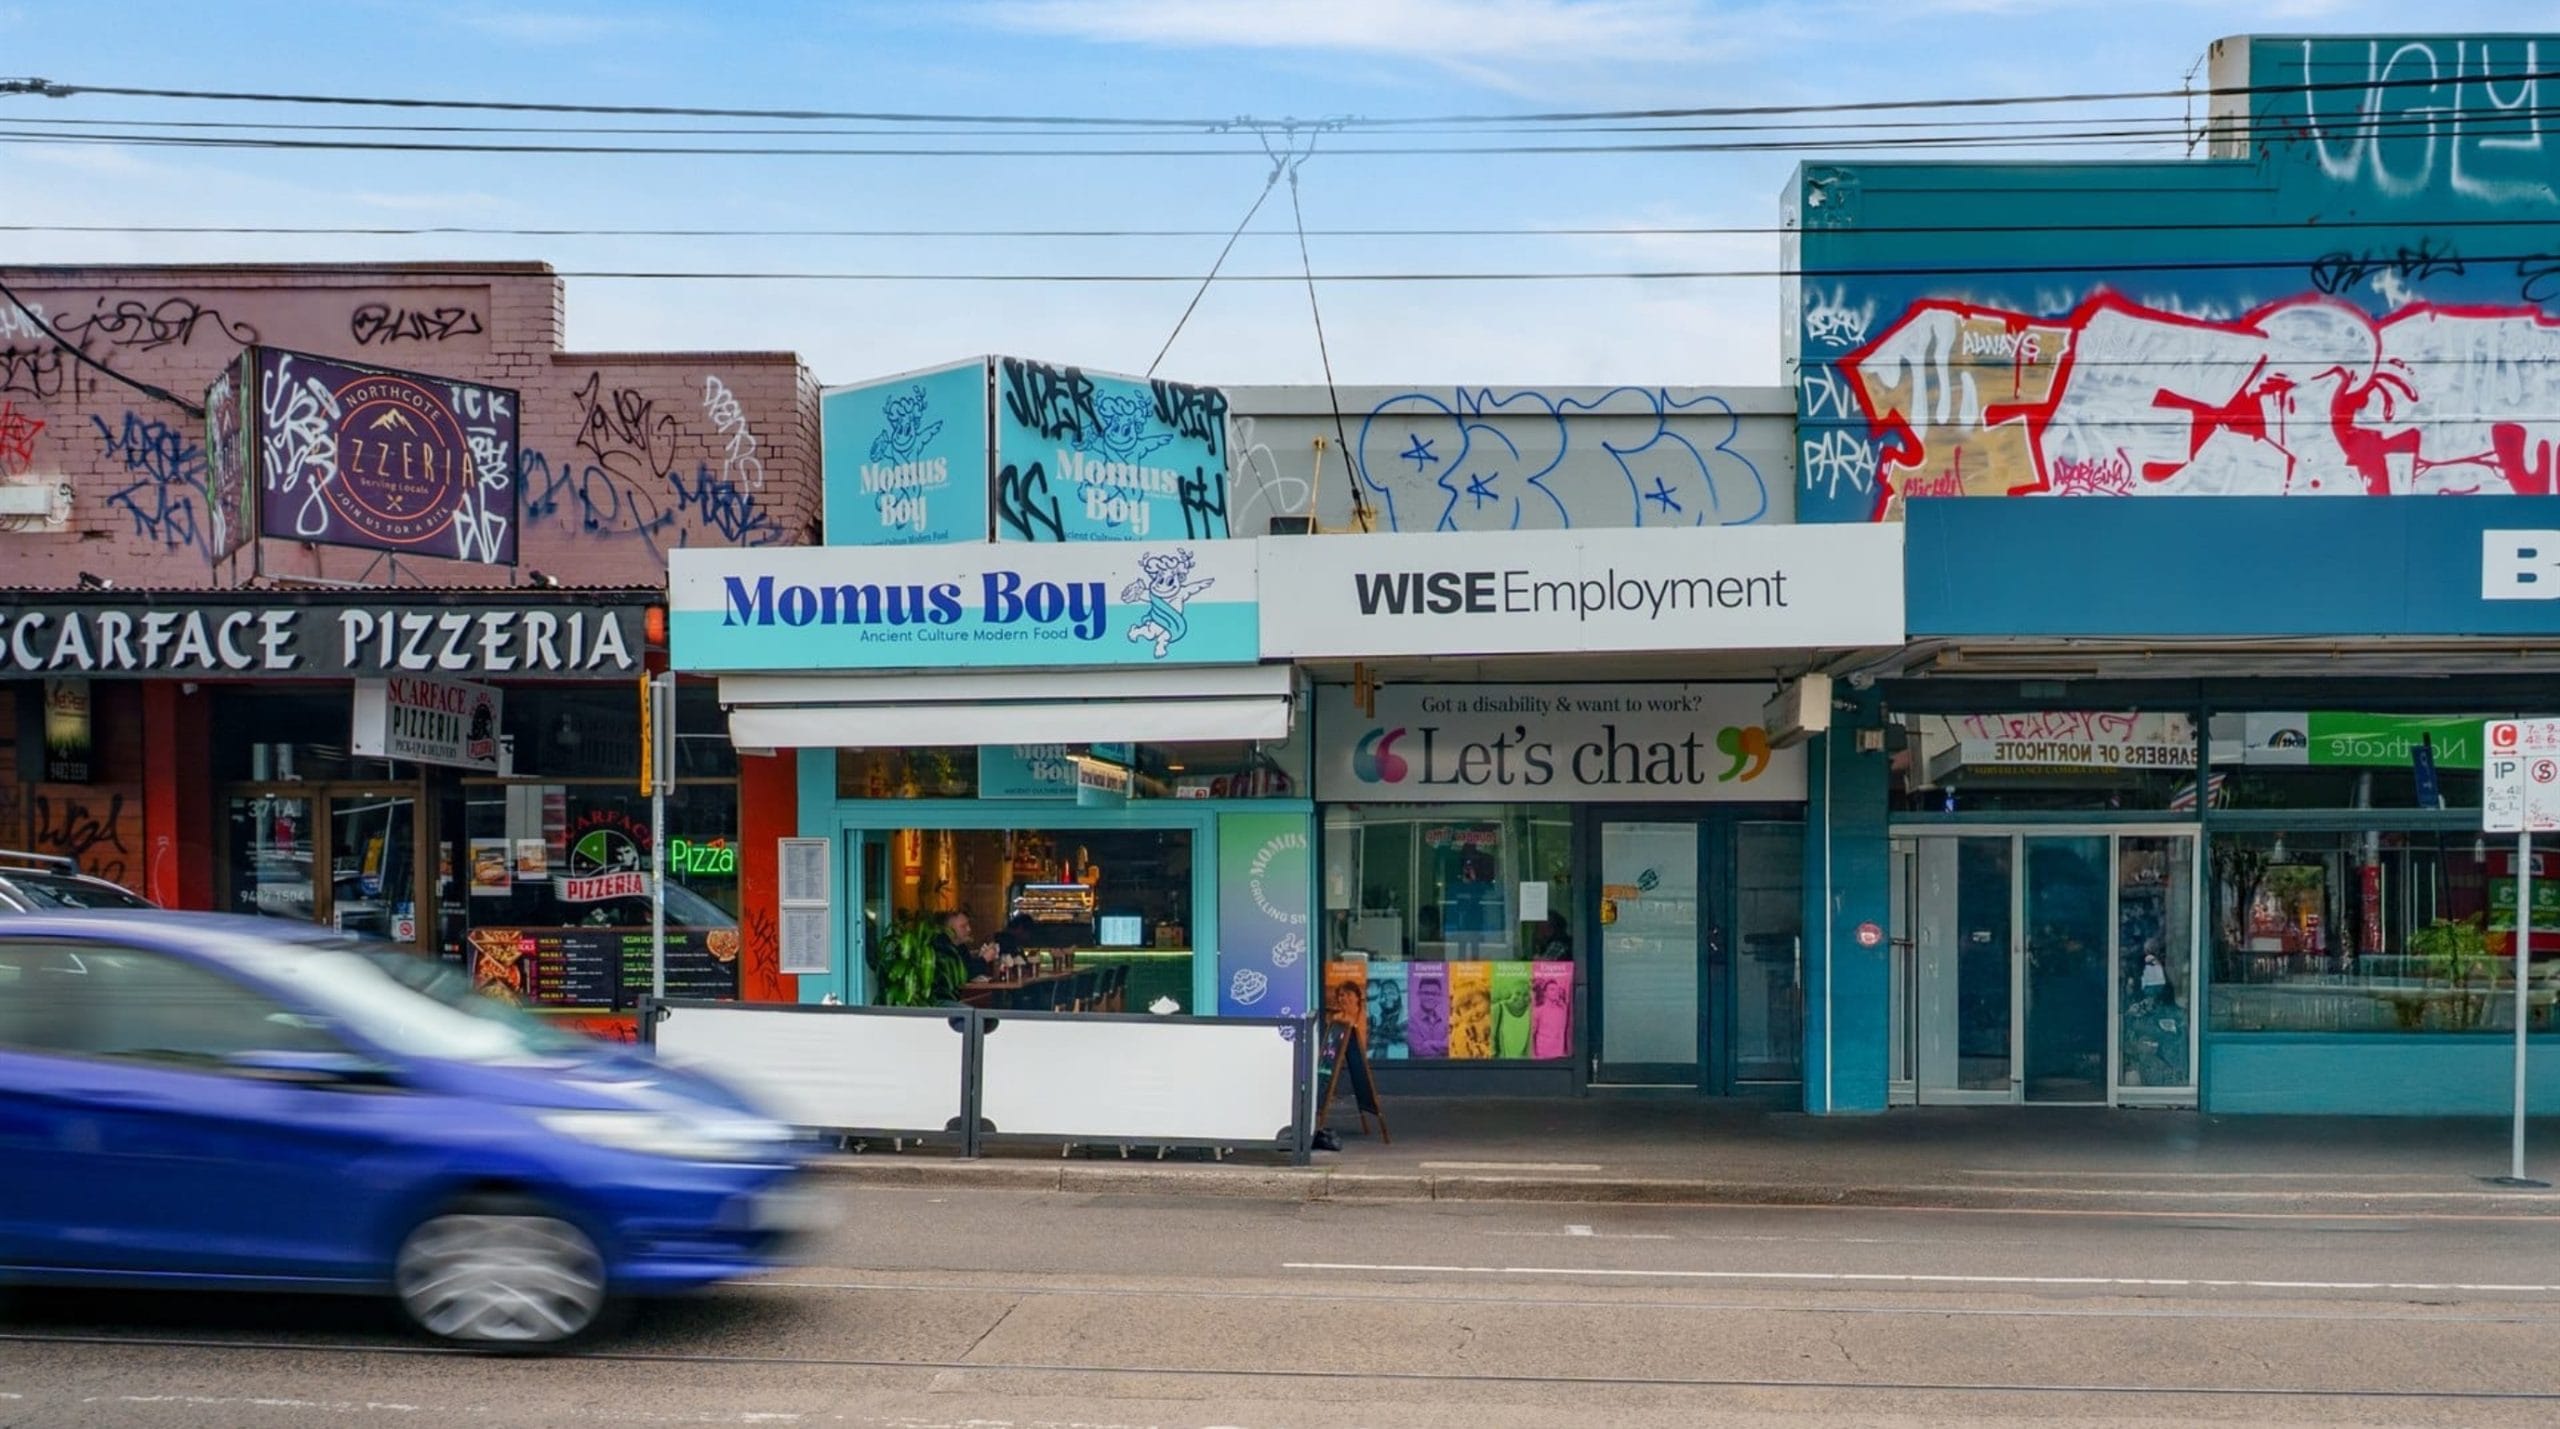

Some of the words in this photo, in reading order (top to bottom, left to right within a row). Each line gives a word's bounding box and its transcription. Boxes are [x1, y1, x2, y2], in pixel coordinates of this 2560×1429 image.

[346, 384, 441, 421] NORTHCOTE
[359, 477, 396, 492] Serving
[859, 455, 948, 495] Momus
[1056, 450, 1179, 500] Momus
[337, 491, 361, 518] JOIN
[366, 516, 381, 530] US
[386, 523, 410, 534] FOR
[415, 523, 422, 533] A
[881, 495, 927, 532] Boy
[1086, 489, 1150, 534] Boy
[722, 576, 964, 627] Momus
[981, 571, 1108, 641] Boy
[1355, 572, 1497, 615] WISE
[1504, 568, 1788, 621] Employment
[0, 609, 300, 671] CARFACE
[338, 609, 633, 671] PIZZERIA
[860, 630, 912, 643] Ancient
[918, 629, 969, 643] Culture
[973, 628, 1029, 642] Modern
[1034, 627, 1068, 641] Food
[388, 677, 467, 715] SCARFACE
[1422, 697, 1454, 713] Got
[1458, 702, 1468, 712] a
[1473, 696, 1551, 717] disability
[1556, 697, 1571, 712] &
[1576, 699, 1622, 712] want
[1625, 699, 1642, 711] to
[1646, 696, 1702, 711] work?
[393, 706, 460, 744] PIZZERIA
[1418, 725, 1554, 786] Let's
[1571, 724, 1706, 786] chat
[2494, 762, 2516, 779] 1P
[671, 839, 734, 873] Pizza
[1250, 832, 1307, 878] MOMUS
[567, 873, 643, 899] PIZZERIA
[1250, 879, 1288, 922] GRILLING
